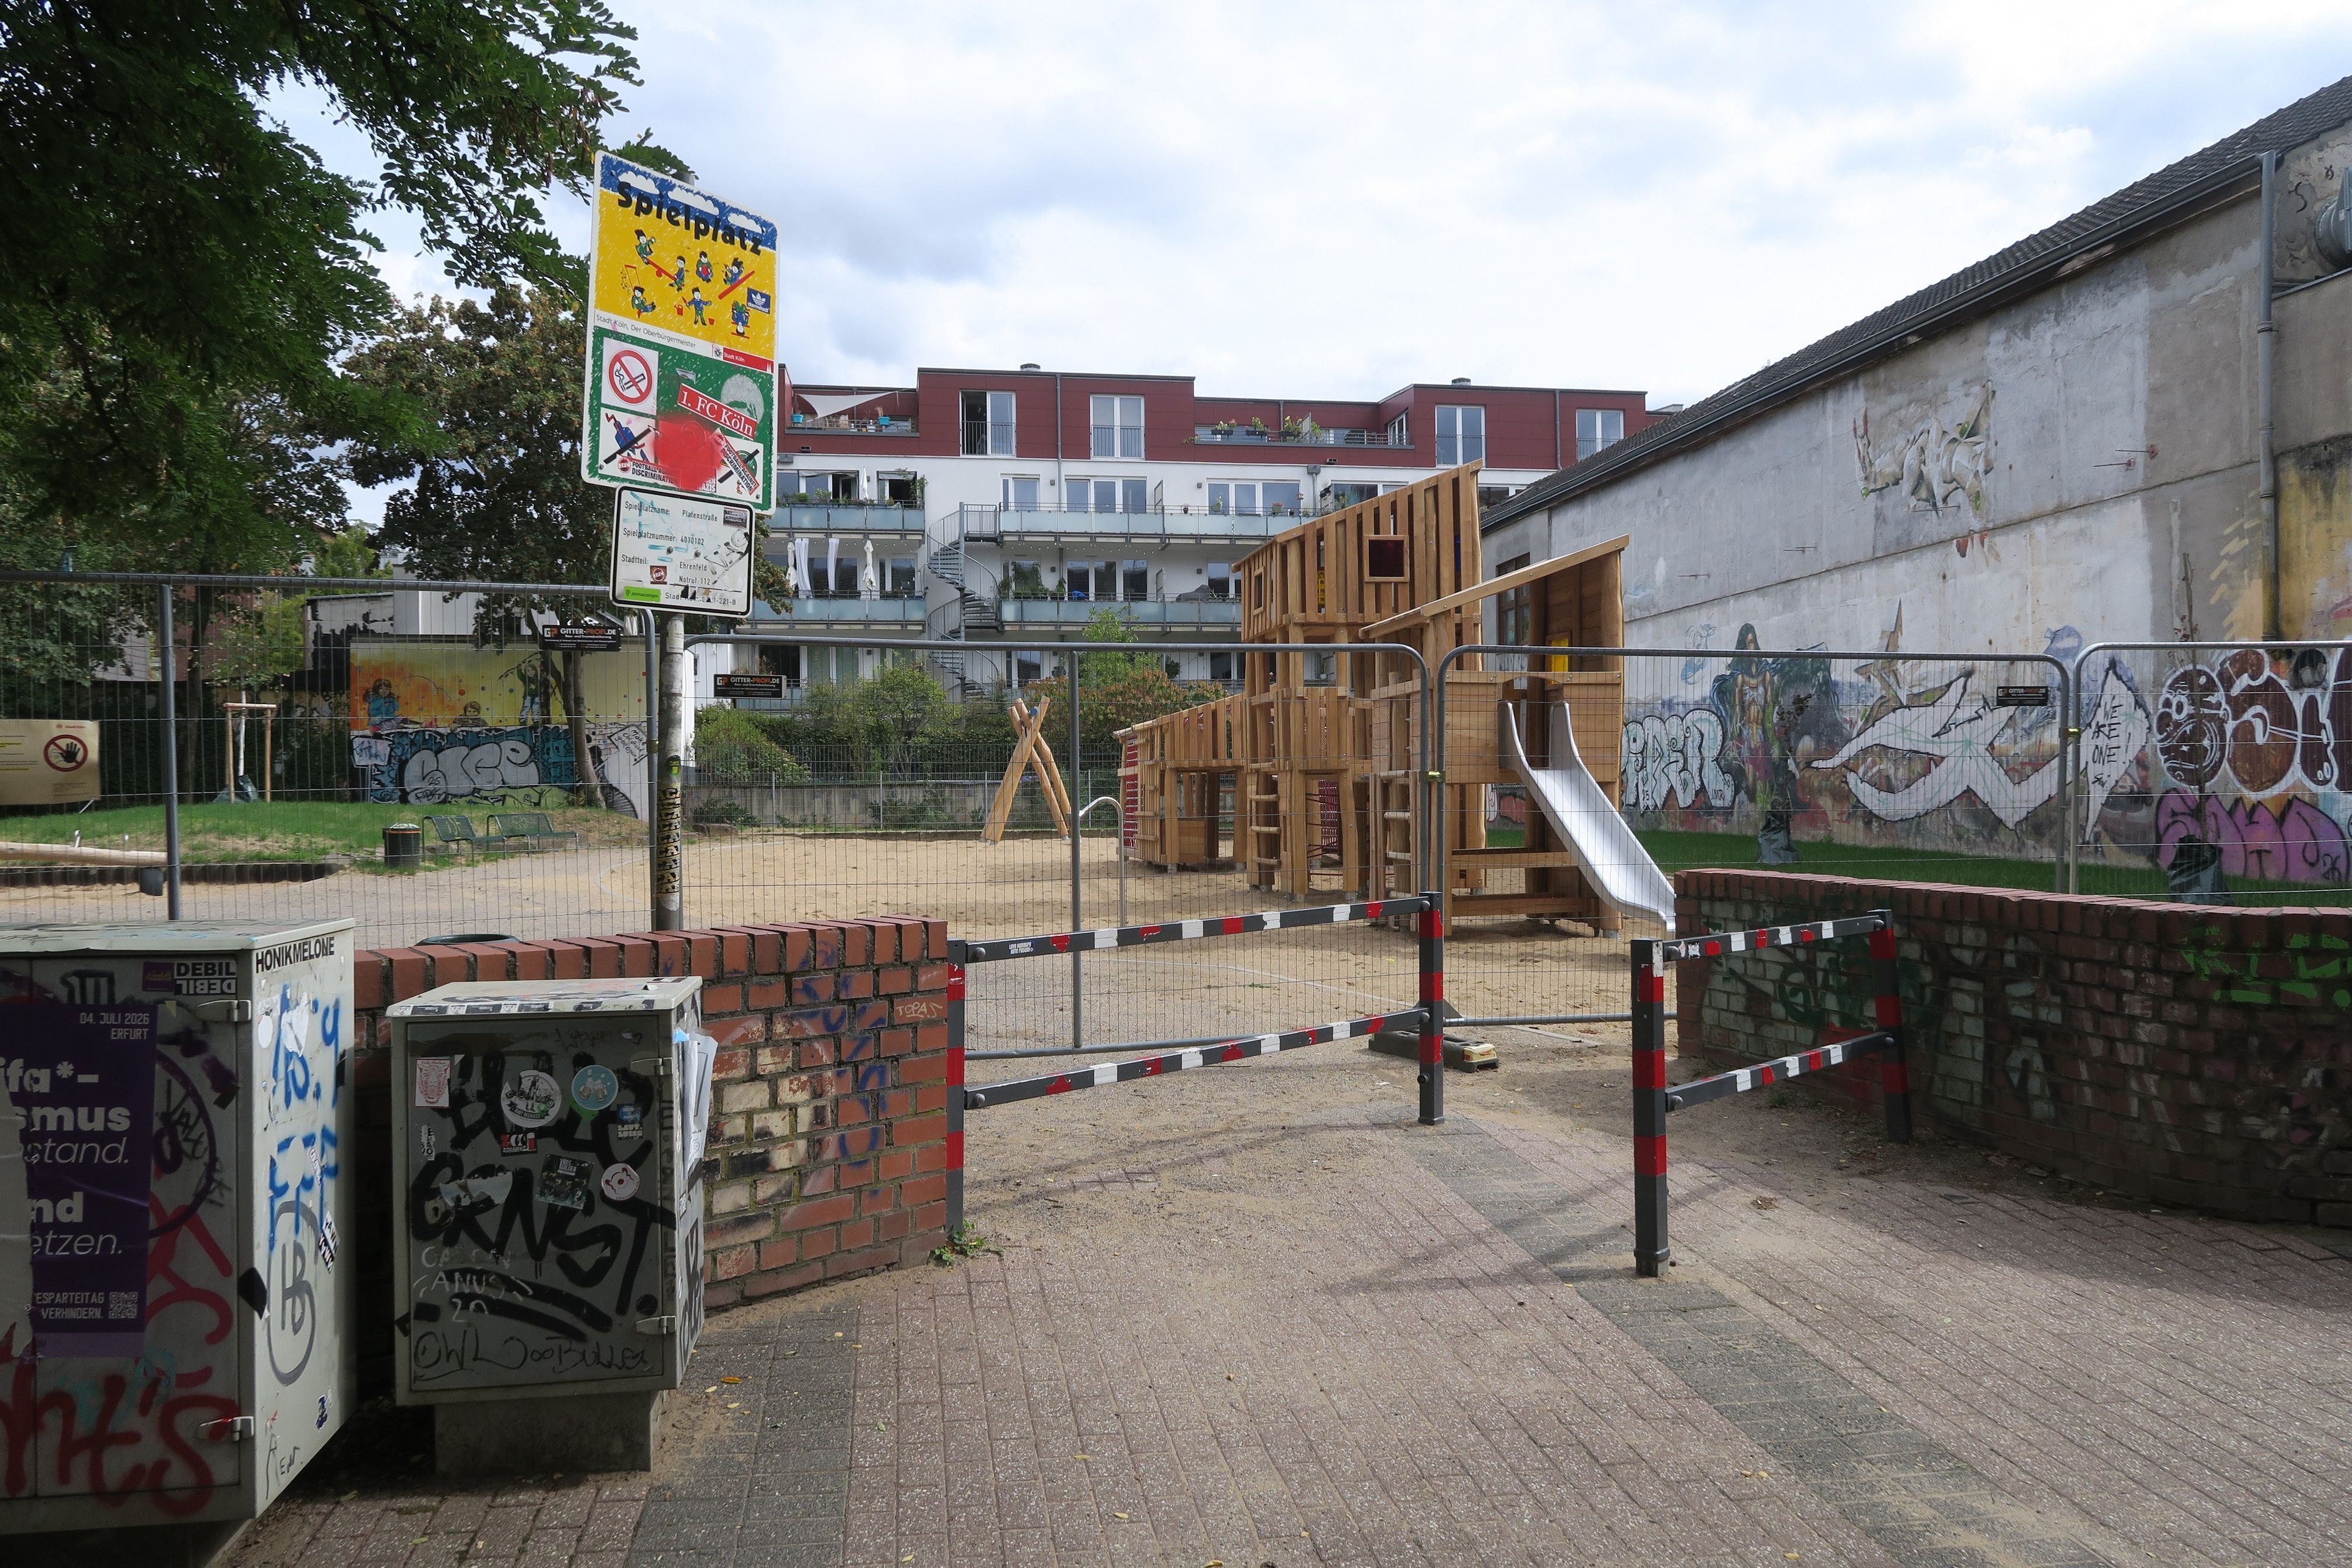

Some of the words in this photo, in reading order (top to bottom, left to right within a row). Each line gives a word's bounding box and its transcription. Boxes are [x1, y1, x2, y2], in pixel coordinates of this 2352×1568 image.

[617, 181, 764, 256] Spielplatz
[596, 314, 613, 325] Stadt
[631, 324, 642, 333] Der
[643, 327, 697, 349] Oberbürgermeister
[724, 352, 735, 360] Stadt
[681, 390, 692, 407] 1.
[695, 397, 718, 418] FC
[720, 409, 754, 437] Köln
[632, 461, 657, 473] FOOTBALL
[720, 447, 754, 492] DISCRIMINATION
[725, 444, 743, 469] FOOTBALL
[741, 467, 757, 487] AGAINST
[682, 509, 719, 522] Platenstraße
[623, 527, 677, 542] Spielplatznummer:
[680, 536, 705, 546] 4010102
[622, 554, 649, 565] Stadtteil:
[679, 561, 707, 571] Ehrenfeld
[679, 576, 699, 585] Notruf:
[700, 577, 711, 586] 112
[256, 937, 335, 974] HONIKMELONE
[176, 961, 236, 977] DEBIL
[176, 979, 236, 995] DEBIL
[79, 1013, 96, 1025] 04.
[99, 1013, 122, 1024] JULI
[124, 1012, 150, 1024] 2026
[111, 1028, 148, 1041] ERFURT
[34, 1292, 105, 1305] ESPARTEITAG
[41, 1307, 103, 1320] VERHINDERN.
